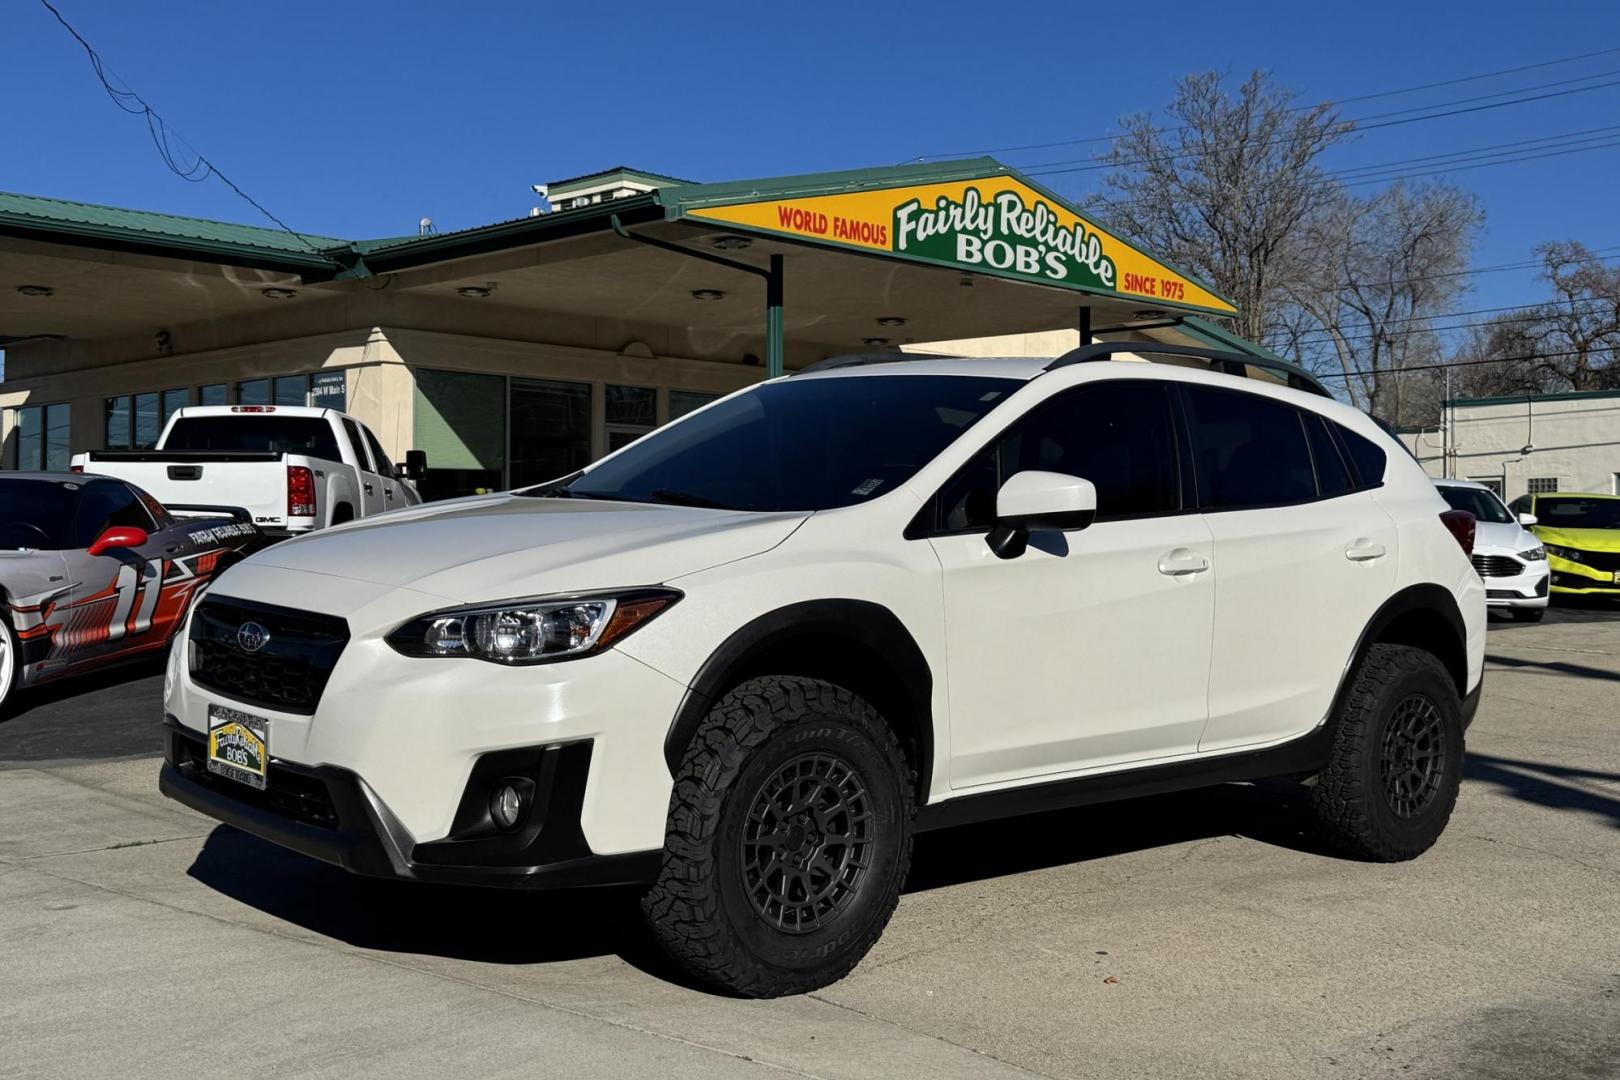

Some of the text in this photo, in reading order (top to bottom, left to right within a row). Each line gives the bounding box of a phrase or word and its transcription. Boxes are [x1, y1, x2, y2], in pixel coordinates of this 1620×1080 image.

[778, 206, 887, 246] WORLD FAMOUS
[897, 190, 1114, 287] Fairly Reliable
[957, 233, 1067, 279] BOB'S
[1124, 272, 1185, 301] SINCE 1975
[255, 516, 281, 524] GMC
